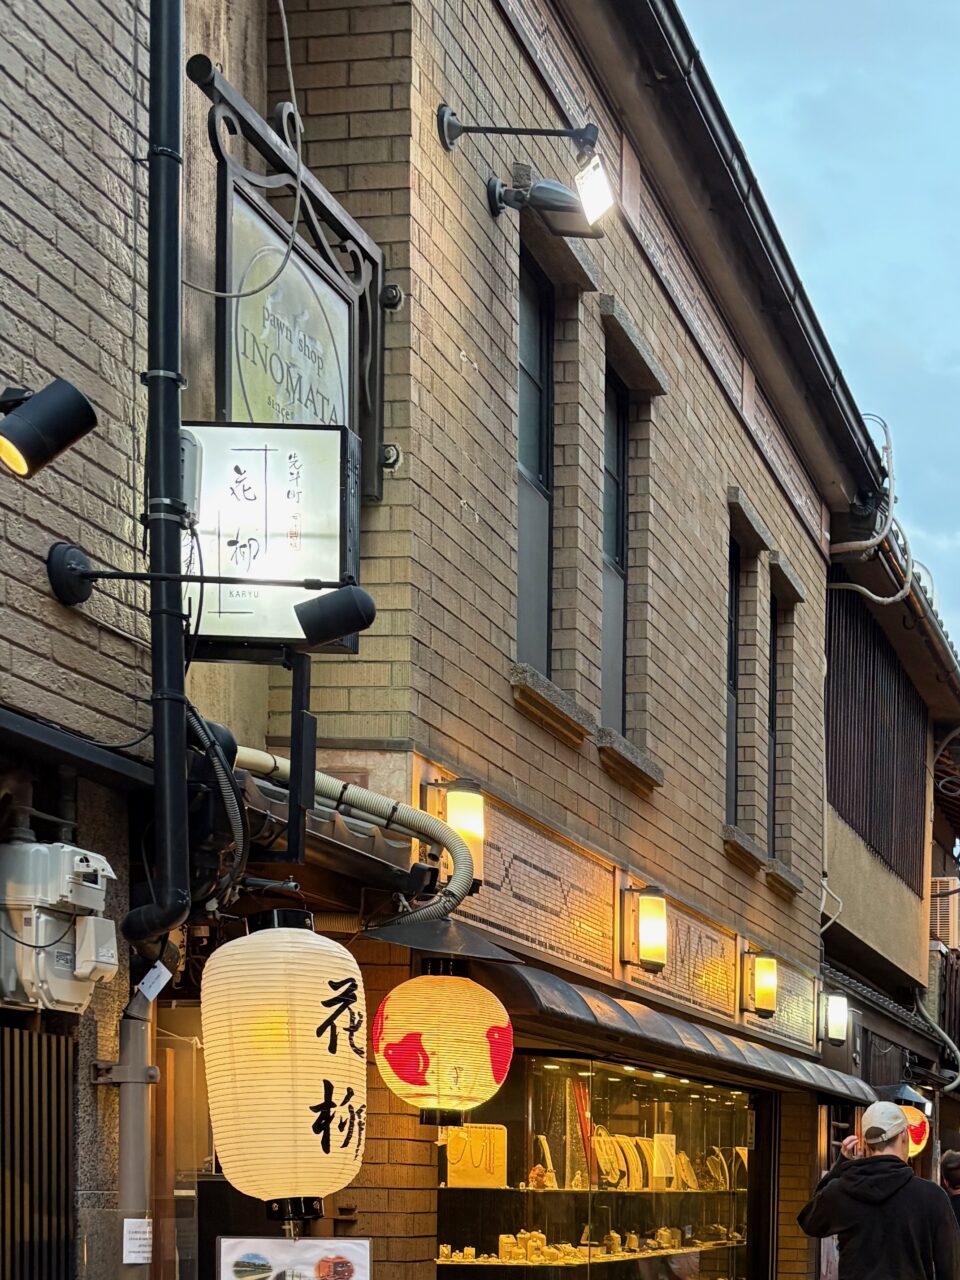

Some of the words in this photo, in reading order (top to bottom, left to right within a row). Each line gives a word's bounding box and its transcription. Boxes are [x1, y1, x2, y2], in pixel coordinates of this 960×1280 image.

[241, 323, 338, 425] INOMATA
[261, 305, 293, 344] pawn
[298, 333, 324, 377] shop
[229, 590, 259, 598] KARYU
[309, 977, 366, 1161] 花柳
